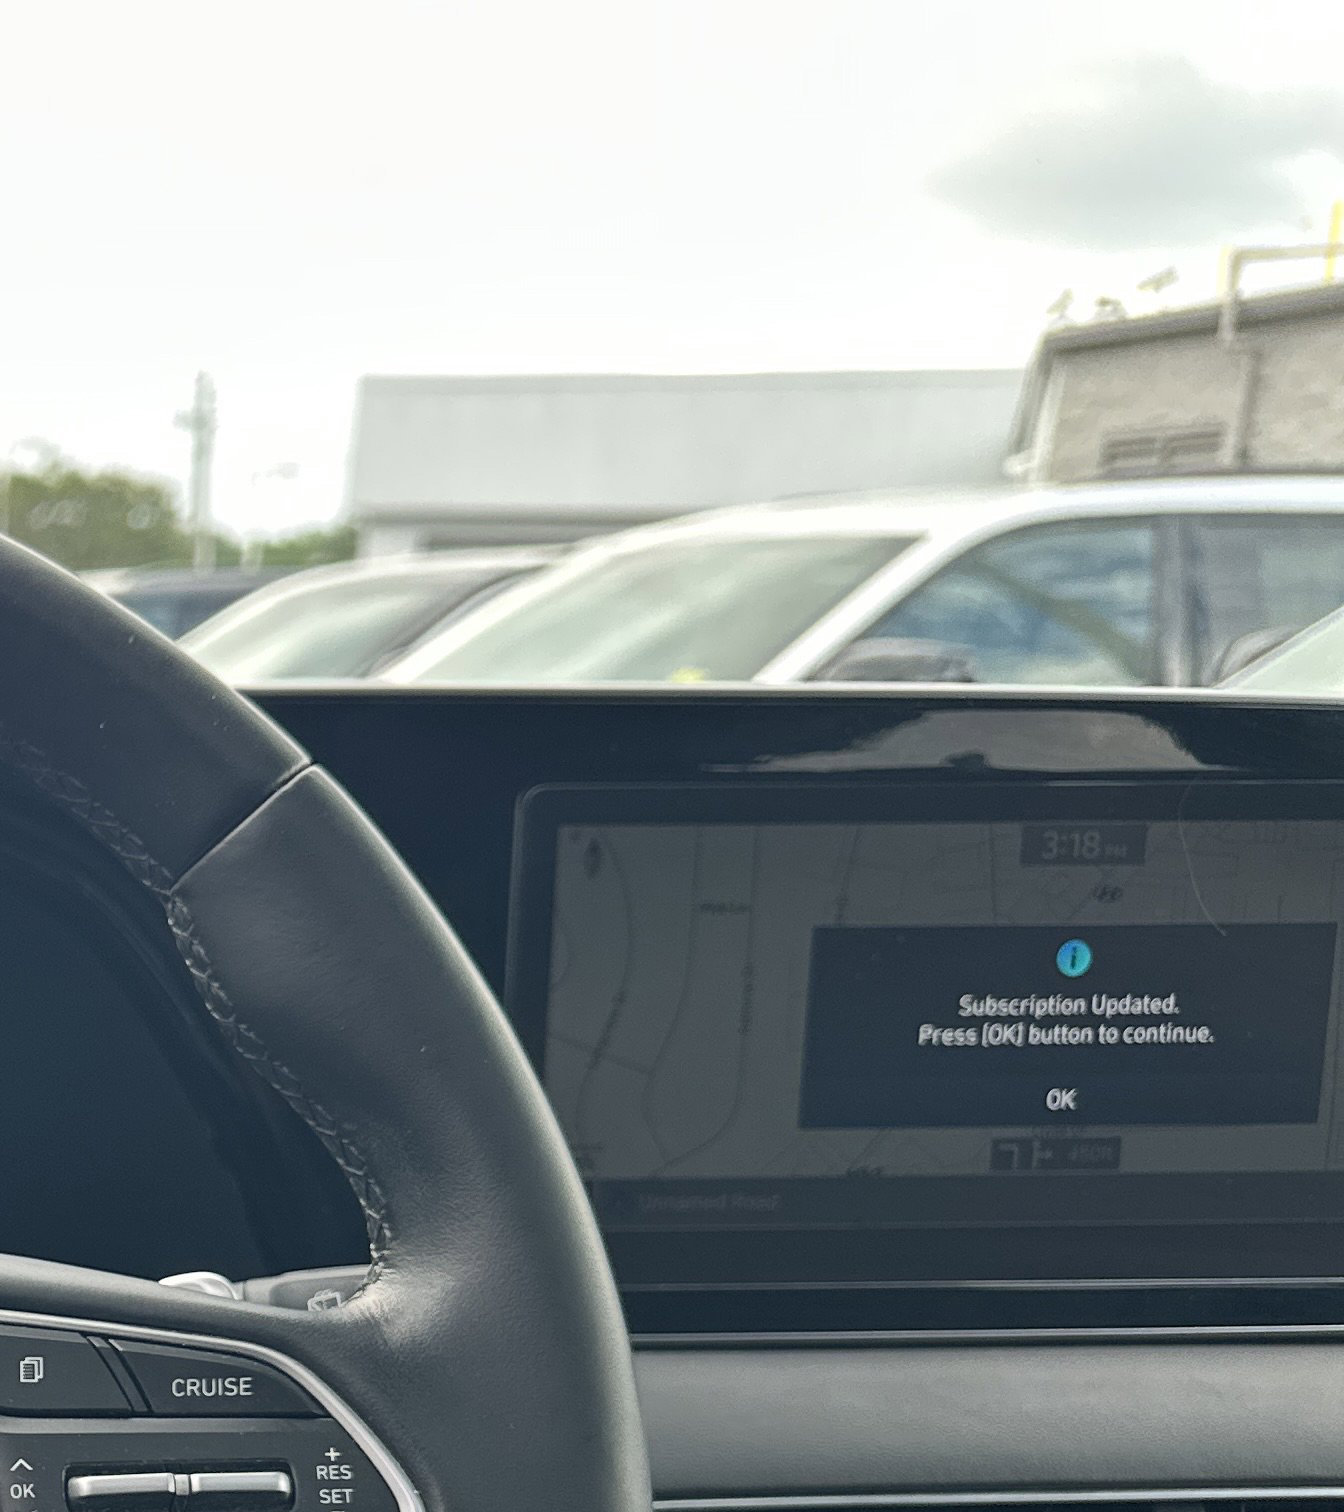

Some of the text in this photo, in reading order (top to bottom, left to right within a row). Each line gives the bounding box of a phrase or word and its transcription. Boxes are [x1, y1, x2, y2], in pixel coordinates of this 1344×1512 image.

[1041, 830, 1101, 860] 3:18
[957, 993, 1181, 1020] Subscription Updated.
[917, 1021, 1216, 1048] Press [OK] button to continue.
[1045, 1087, 1079, 1112] OK
[170, 1376, 254, 1398] CRUISE
[315, 1464, 352, 1481] RES
[9, 1482, 37, 1500] OK
[318, 1487, 354, 1504] SET
